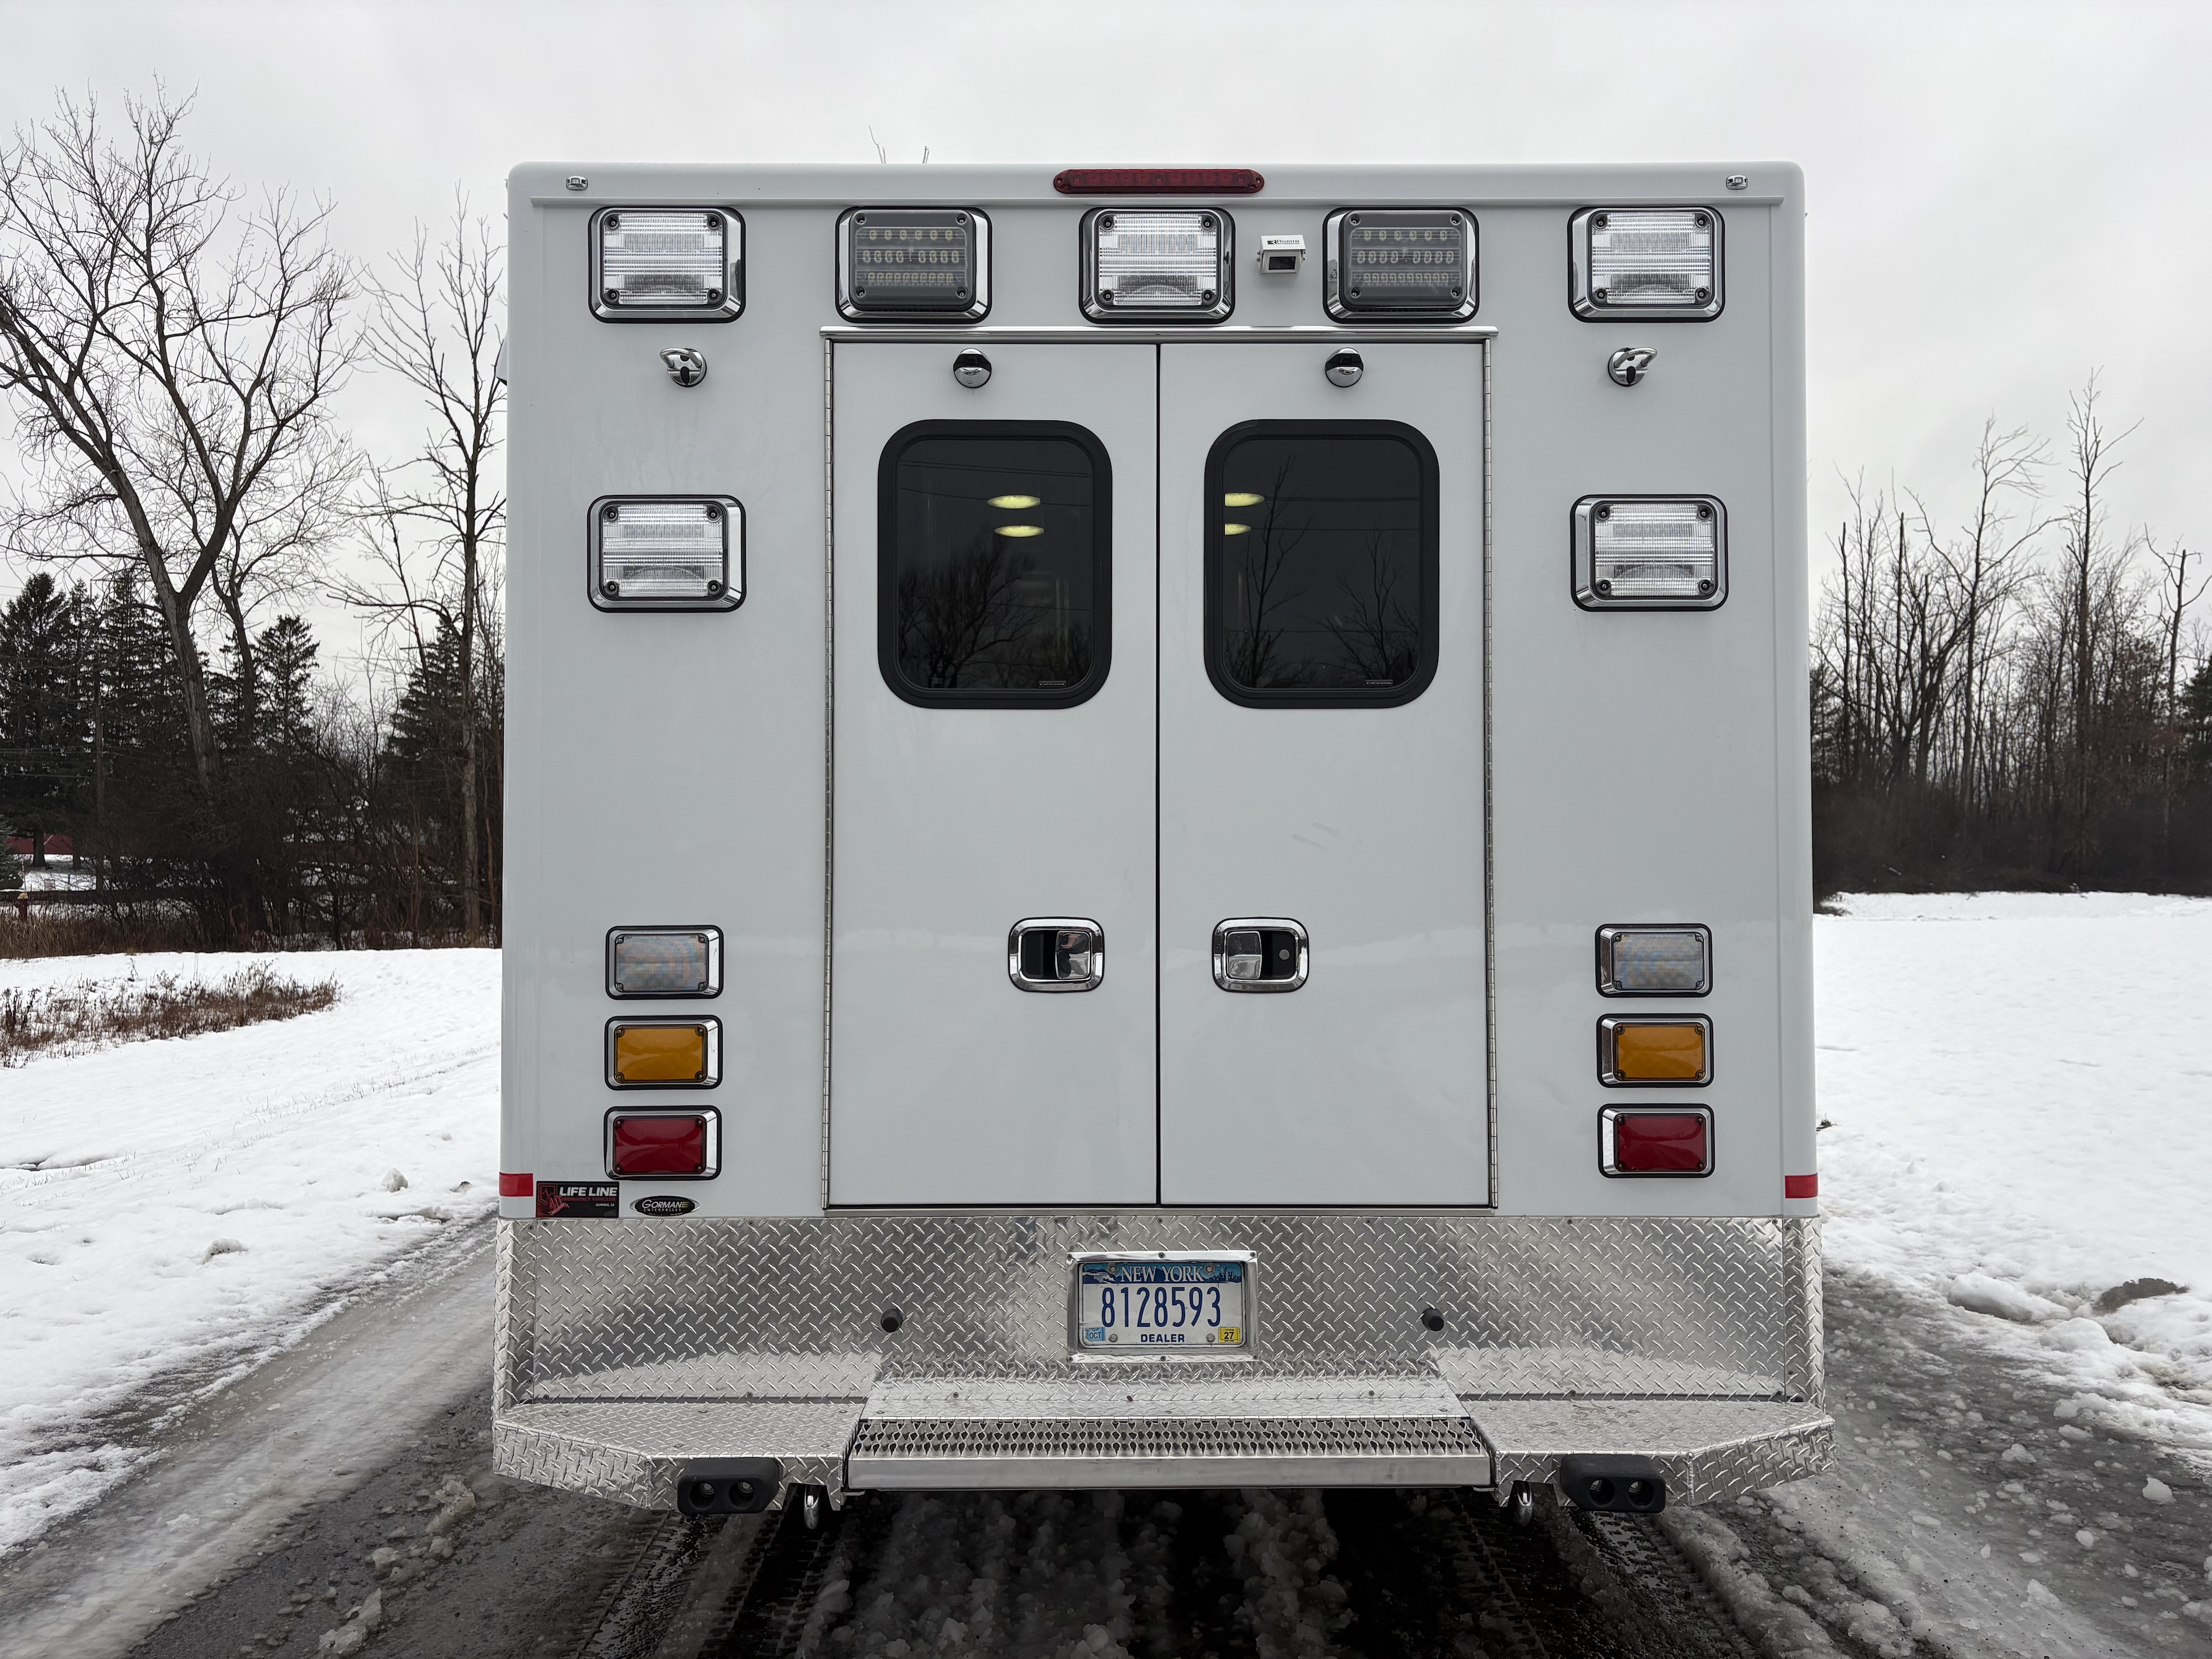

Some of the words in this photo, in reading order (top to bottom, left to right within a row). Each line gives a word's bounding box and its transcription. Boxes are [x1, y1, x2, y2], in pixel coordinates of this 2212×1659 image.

[559, 1186, 587, 1197] LIFE
[588, 1187, 618, 1197] LINE
[1120, 1265, 1157, 1282] NEW
[1161, 1265, 1204, 1282] YORK
[1101, 1286, 1221, 1328] 8128593
[1140, 1333, 1185, 1343] DEALER
